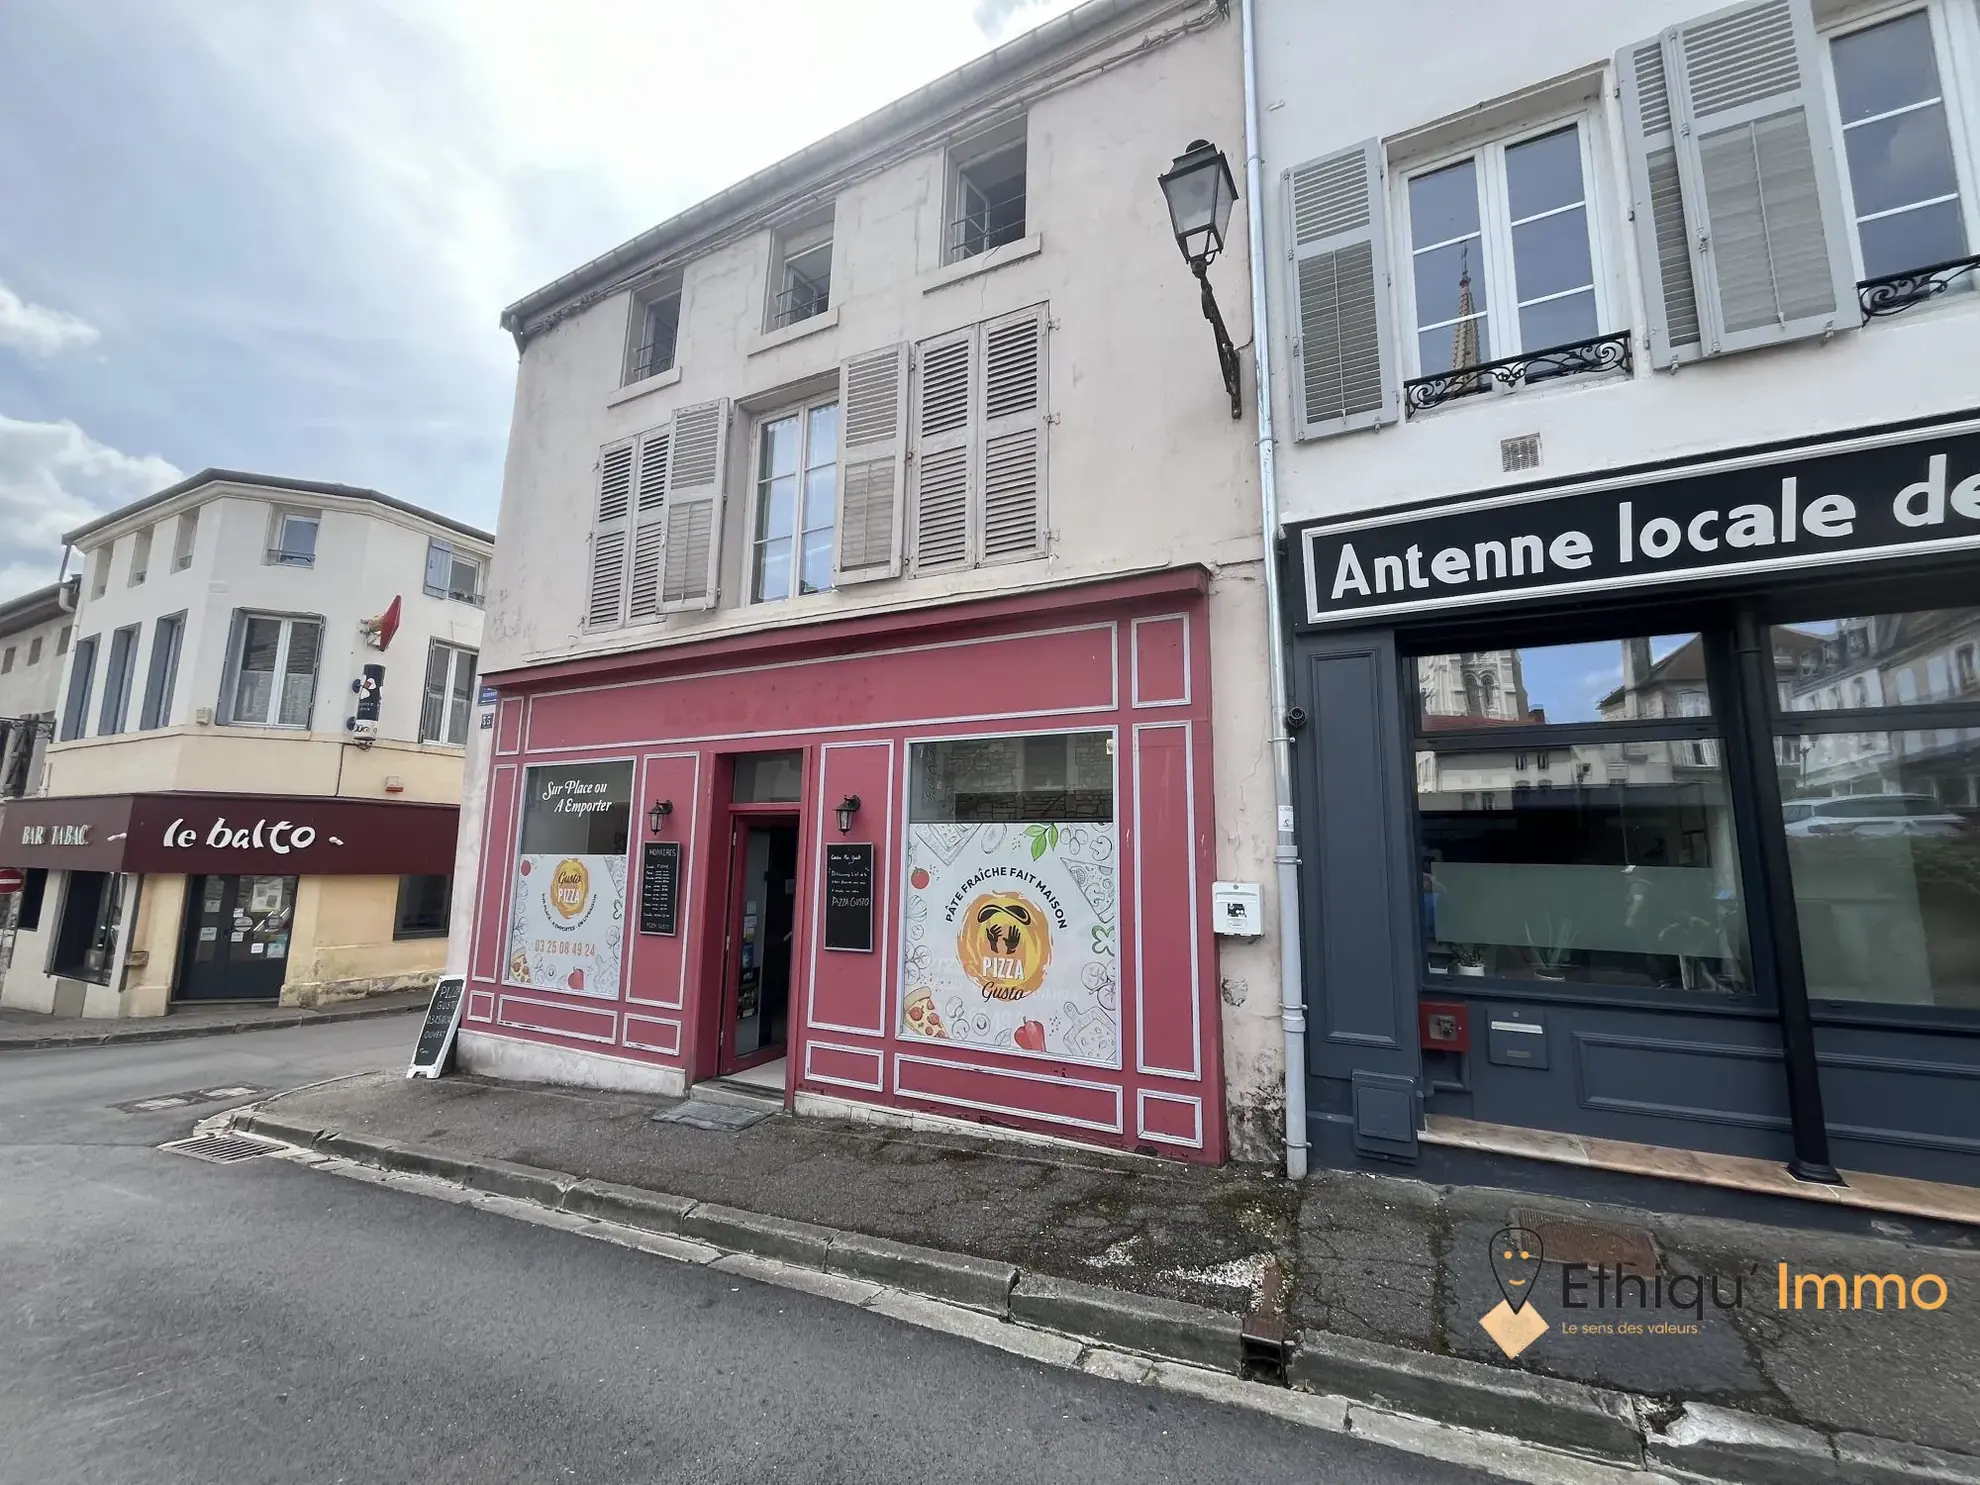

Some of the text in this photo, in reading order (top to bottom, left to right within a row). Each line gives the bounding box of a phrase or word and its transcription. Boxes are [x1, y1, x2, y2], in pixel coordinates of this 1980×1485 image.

[1331, 531, 1593, 599] Antenne
[1619, 476, 1856, 563] locale
[542, 780, 608, 800] Sur Place ou
[553, 797, 613, 818] A Emporter
[21, 825, 90, 845] BAR TABAC
[163, 817, 316, 854] le balto
[557, 871, 581, 887] Gusto
[557, 888, 580, 904] PIZZA
[945, 867, 1068, 929] PÂTE FRAÎCHE FAIT MAISON
[535, 940, 595, 957] 03 25 08 49 24
[982, 957, 1025, 980] PIZZA
[981, 981, 1025, 1002] Gusto
